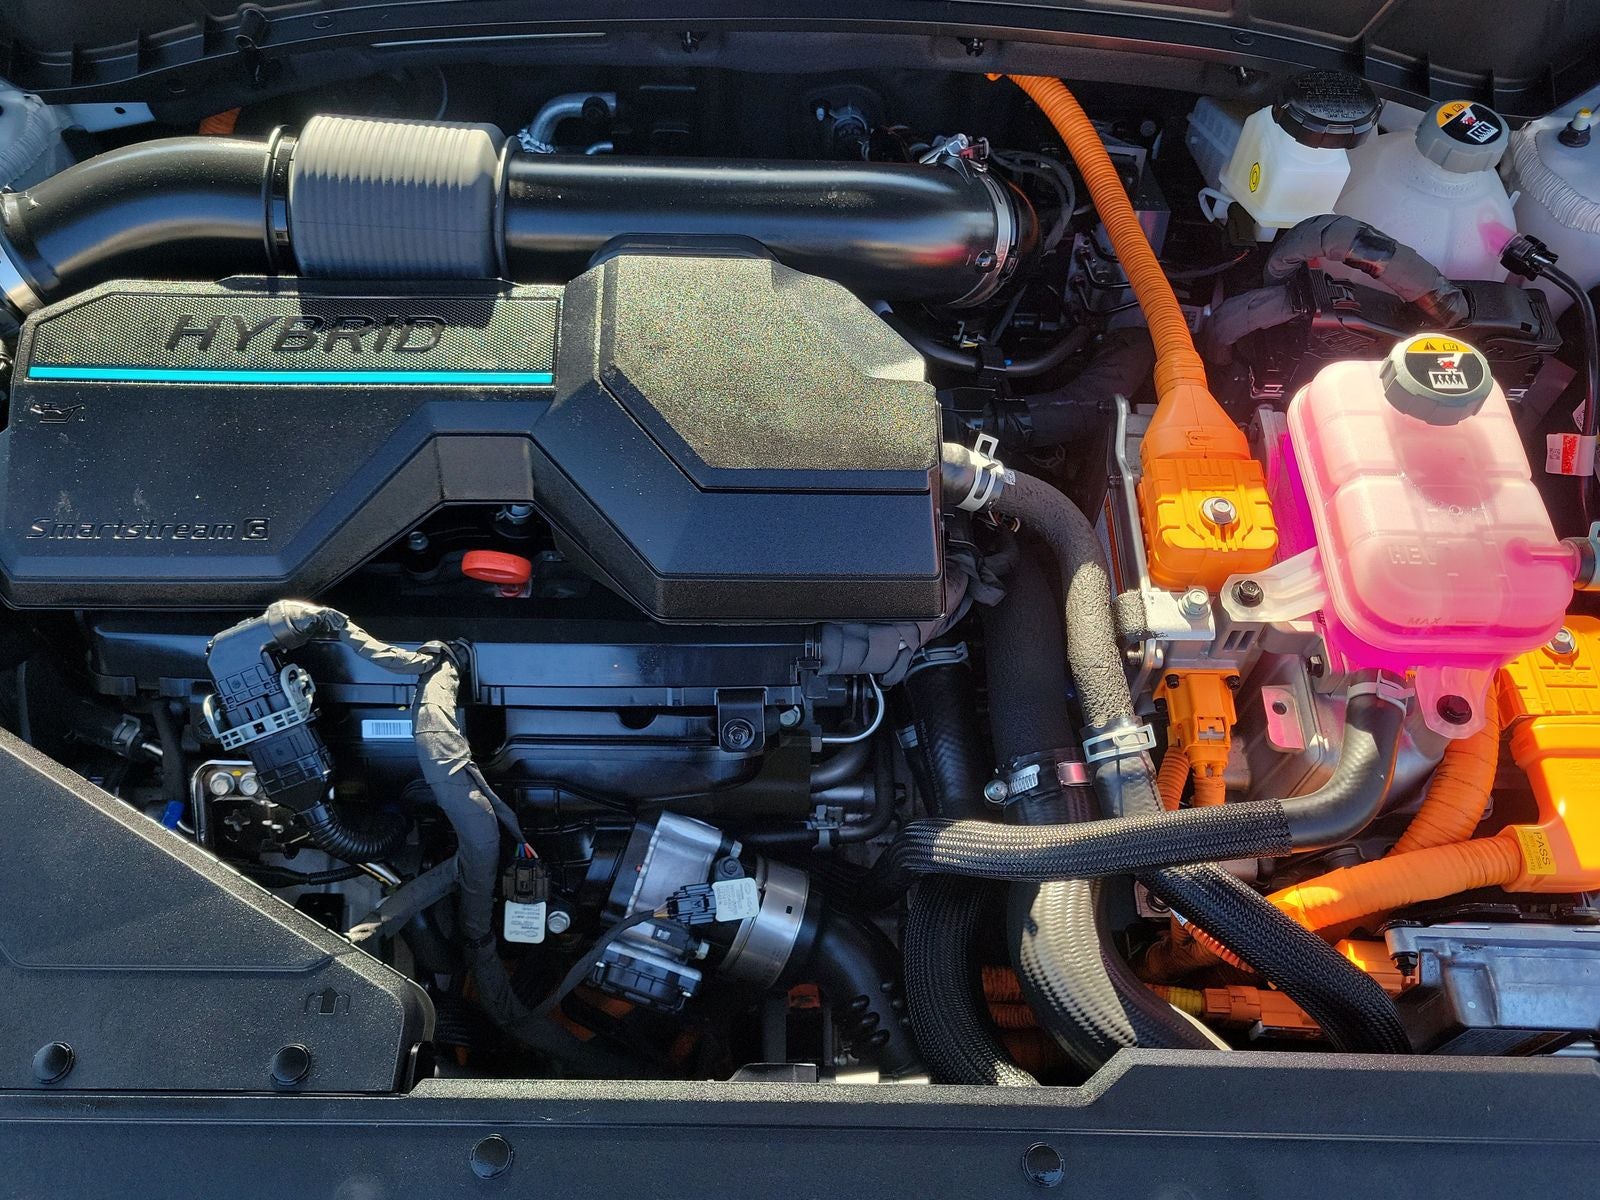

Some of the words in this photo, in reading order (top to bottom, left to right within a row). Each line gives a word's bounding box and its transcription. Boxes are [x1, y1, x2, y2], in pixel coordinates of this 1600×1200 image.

[164, 314, 446, 352] HYBRID
[26, 517, 236, 541] Smartstream
[1408, 616, 1442, 625] MAX
[1533, 831, 1551, 866] PASS
